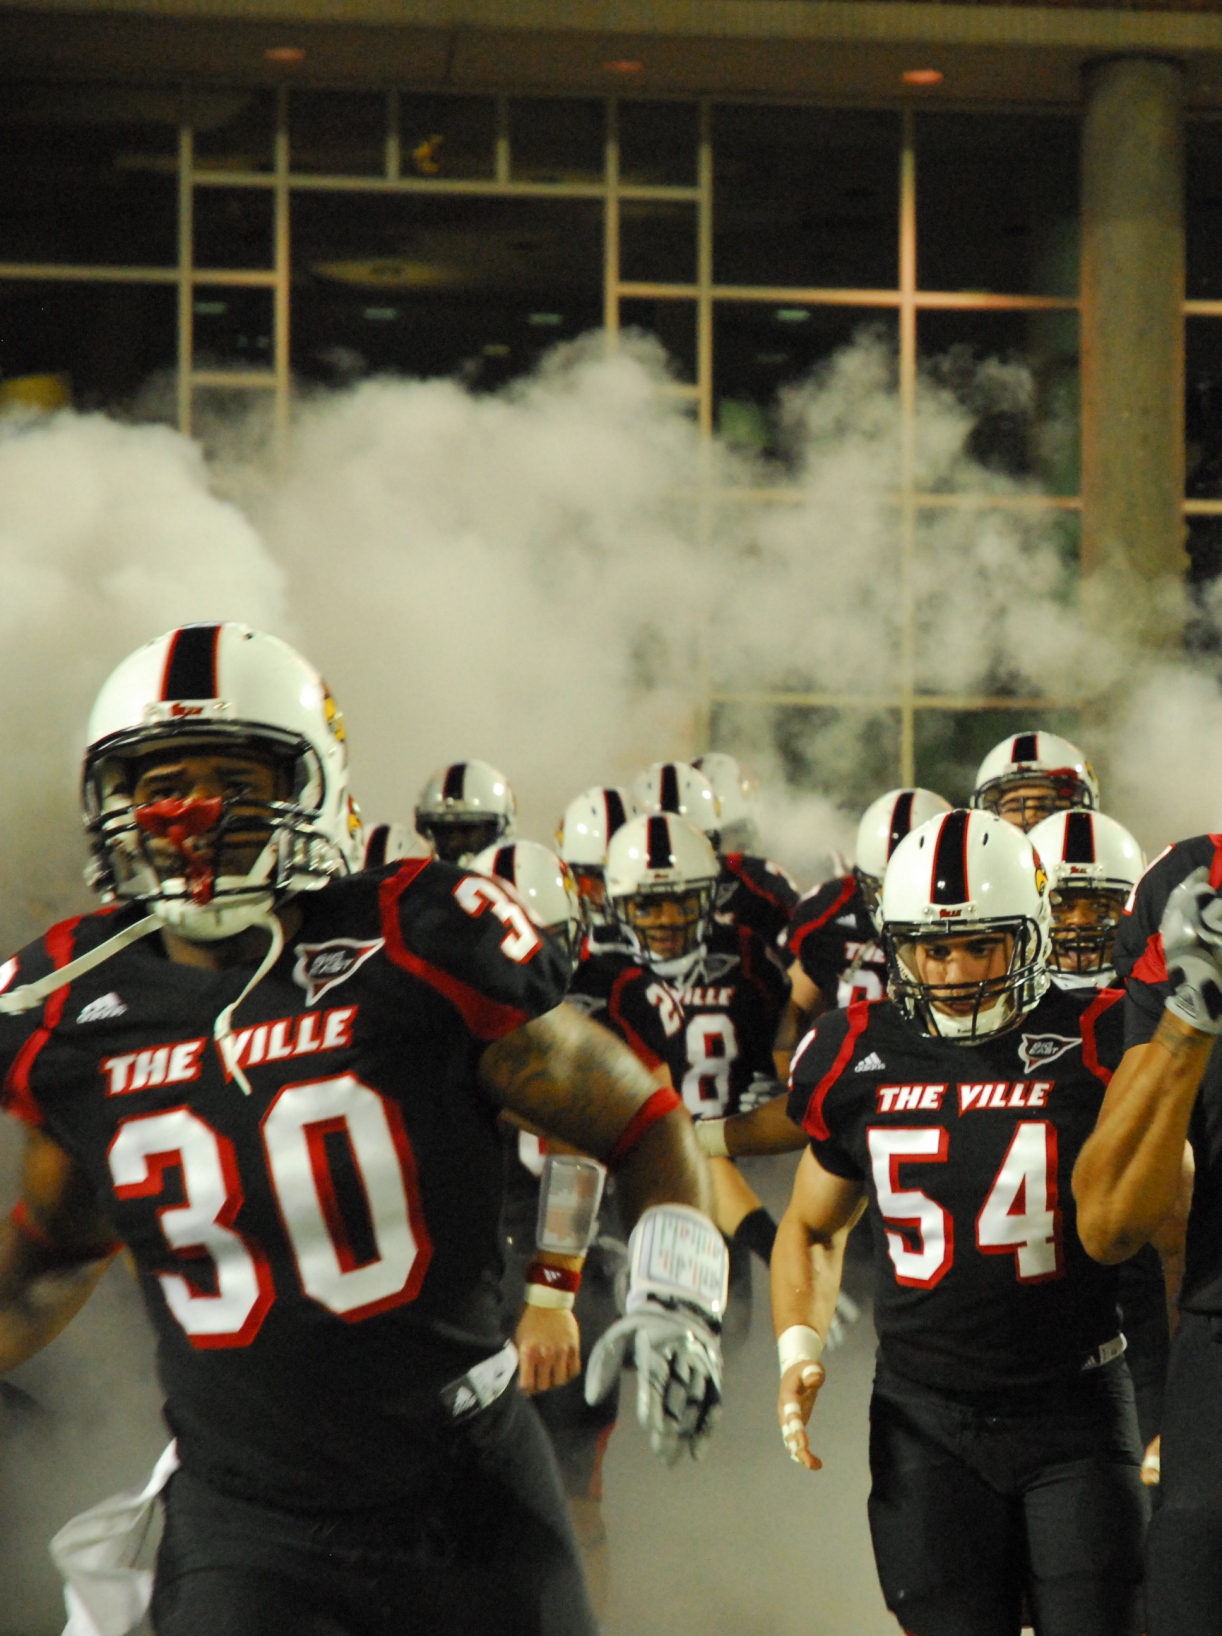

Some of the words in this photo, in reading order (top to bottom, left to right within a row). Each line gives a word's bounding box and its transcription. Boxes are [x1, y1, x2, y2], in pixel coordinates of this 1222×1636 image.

[452, 875, 548, 965] 3
[102, 1036, 207, 1097] THE
[216, 1005, 358, 1085] VILLE
[876, 1083, 949, 1114] THE
[957, 1081, 1054, 1117] VILLE
[106, 1070, 434, 1350] 30
[866, 1119, 1066, 1290] 54
